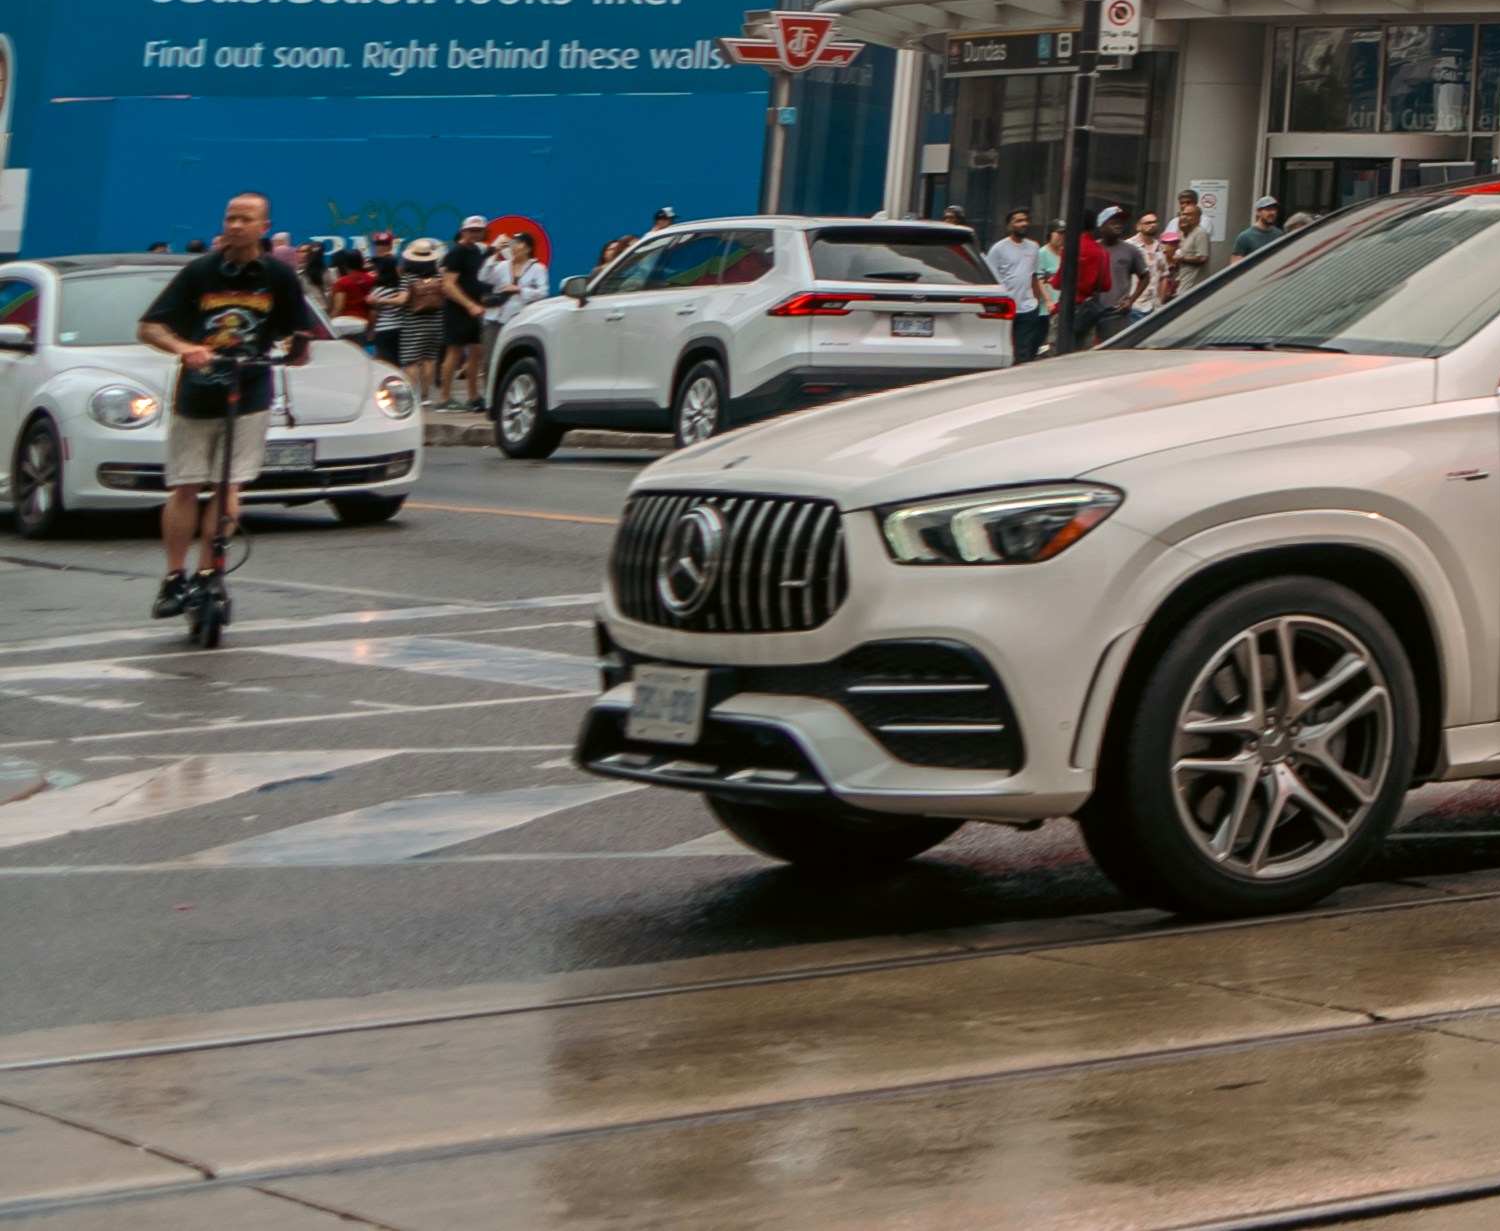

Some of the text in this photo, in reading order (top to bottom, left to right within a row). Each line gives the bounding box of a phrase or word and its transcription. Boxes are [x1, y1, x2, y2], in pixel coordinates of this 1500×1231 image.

[143, 39, 732, 76] Find out soon. Right behind these walls.
[962, 39, 1008, 63] Dundas
